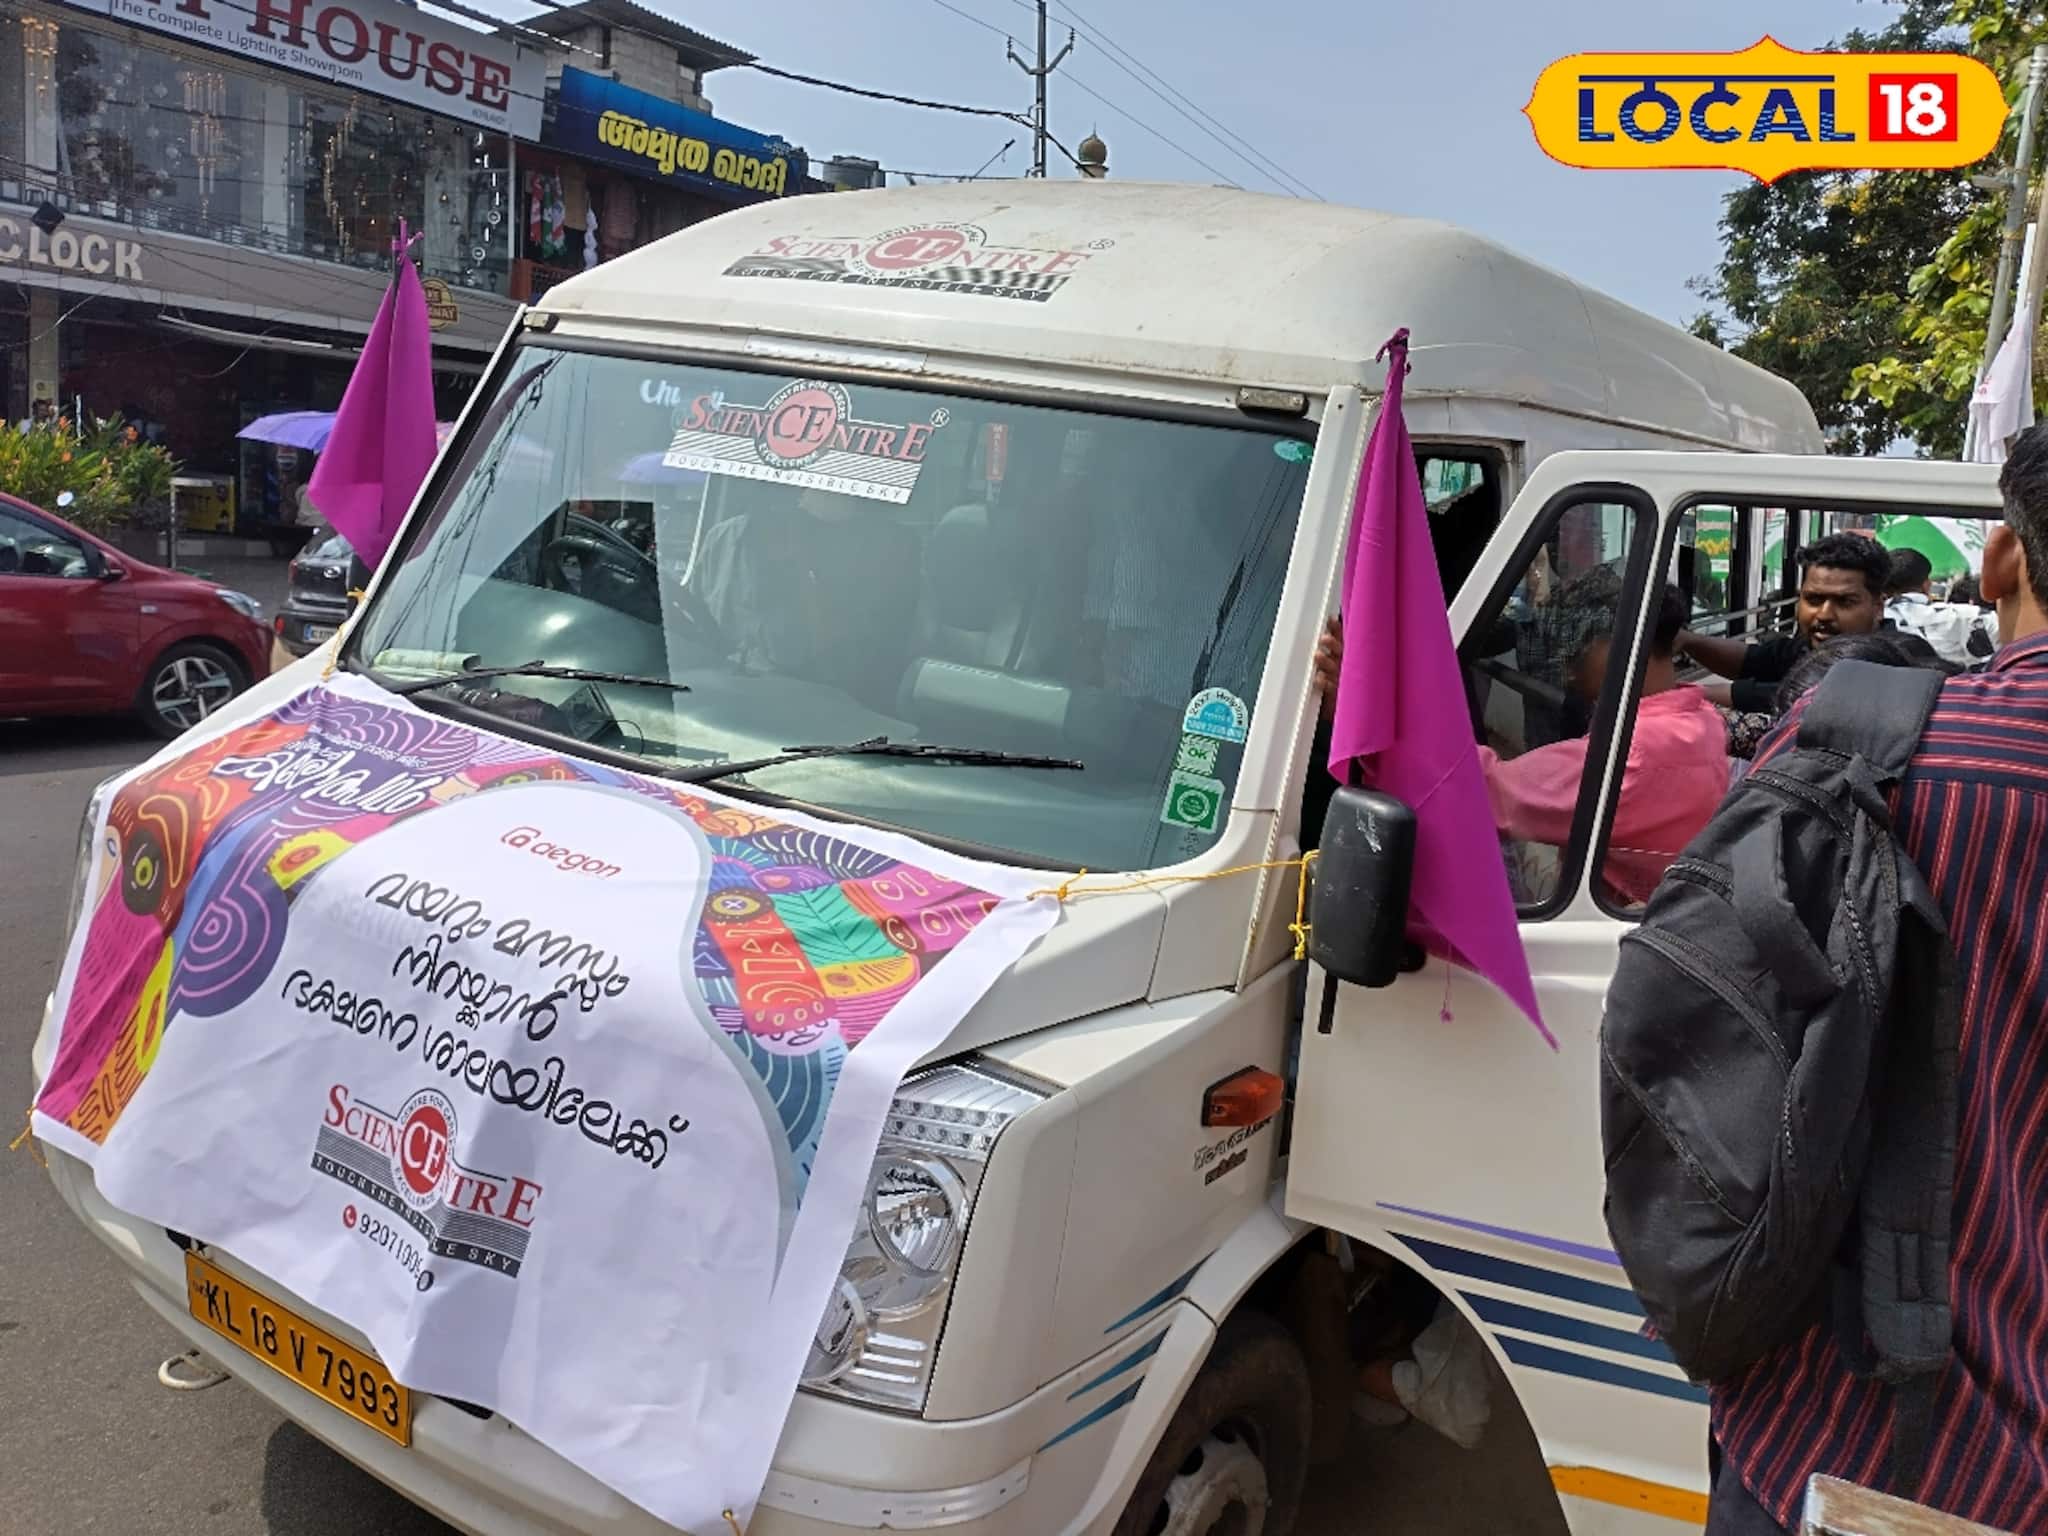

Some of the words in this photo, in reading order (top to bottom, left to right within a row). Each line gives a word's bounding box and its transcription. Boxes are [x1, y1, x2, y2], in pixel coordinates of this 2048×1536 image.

[113, 0, 143, 16] The
[149, 4, 223, 40] Complete
[227, 31, 287, 61] Lighting
[247, 0, 511, 112] HOUSE
[599, 109, 710, 175] അമൃത
[713, 148, 787, 196] ഖാദി
[669, 455, 722, 470] TOUCH
[728, 462, 758, 476] THE
[764, 468, 859, 493] INVISIBLE
[1188, 747, 1208, 761] OK
[530, 842, 622, 877] aegon
[365, 873, 491, 943] വയറും
[315, 1156, 367, 1189] TOUCH
[371, 1184, 396, 1207] THE
[468, 1247, 513, 1271] SKY
[360, 1213, 434, 1292] 92071000
[206, 1279, 241, 1336] KL
[251, 1306, 278, 1356] 18
[290, 1328, 305, 1373] V
[317, 1345, 399, 1427] 7993
